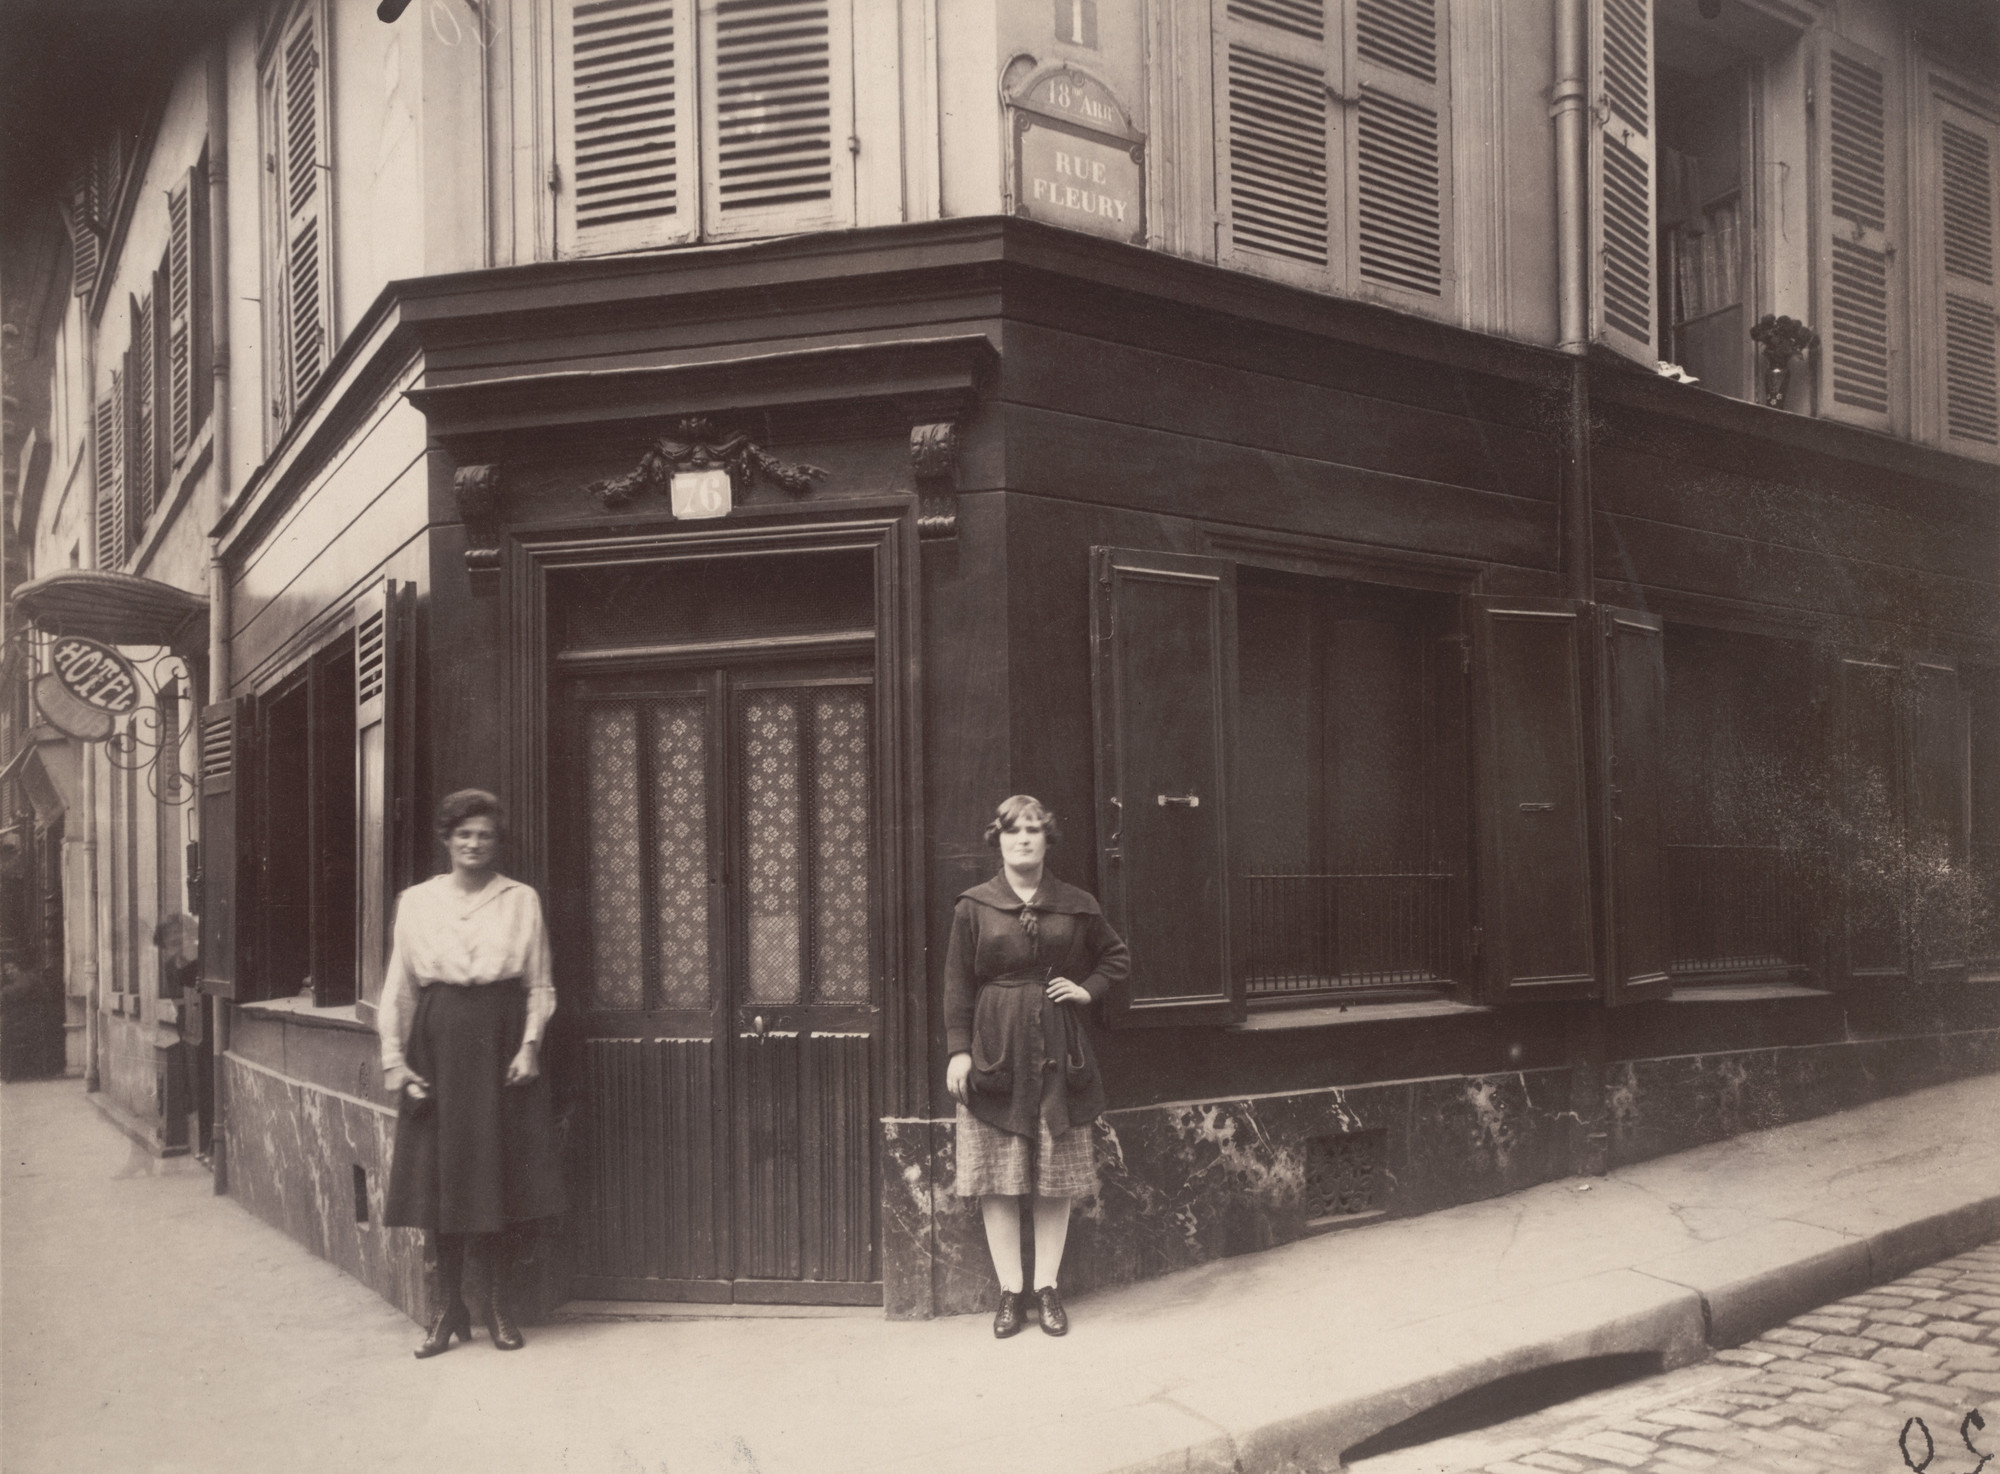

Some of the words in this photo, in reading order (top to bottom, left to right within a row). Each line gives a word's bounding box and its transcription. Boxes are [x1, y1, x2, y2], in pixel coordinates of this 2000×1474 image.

[1055, 151, 1106, 185] RUE
[1033, 178, 1127, 222] FLEURY
[675, 478, 722, 513] 76
[54, 642, 135, 712] HOTEL
